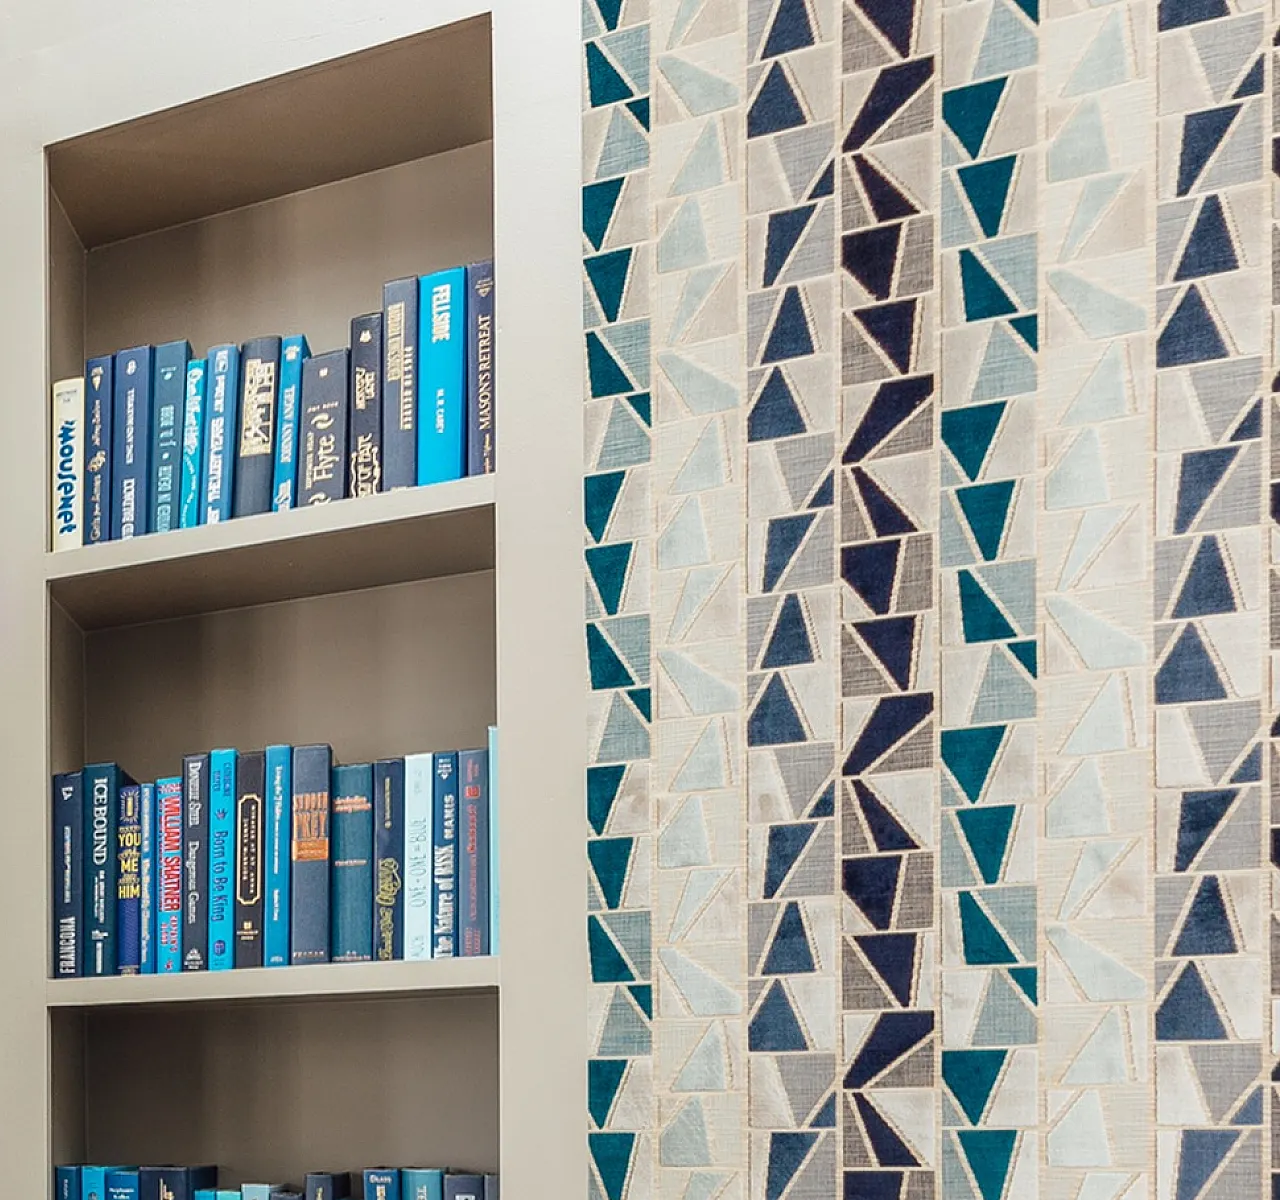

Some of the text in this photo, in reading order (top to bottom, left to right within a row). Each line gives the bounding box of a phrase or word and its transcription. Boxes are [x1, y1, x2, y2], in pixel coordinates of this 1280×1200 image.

[431, 284, 451, 343] FELLSIDE
[478, 314, 492, 430] MASON'S RETREAT
[313, 434, 339, 482] Flyte
[93, 776, 109, 866] ICE BOUND
[118, 832, 141, 848] YOU
[163, 795, 182, 912] WILLIAM SHATNER
[118, 885, 140, 899] HIM
[121, 858, 138, 873] ME
[211, 831, 229, 923] Born to Be King
[410, 817, 427, 908] ONE ONE BLUE
[434, 794, 455, 958] The Nature of RISK MAMIS
[59, 916, 76, 974] FRANCONA
